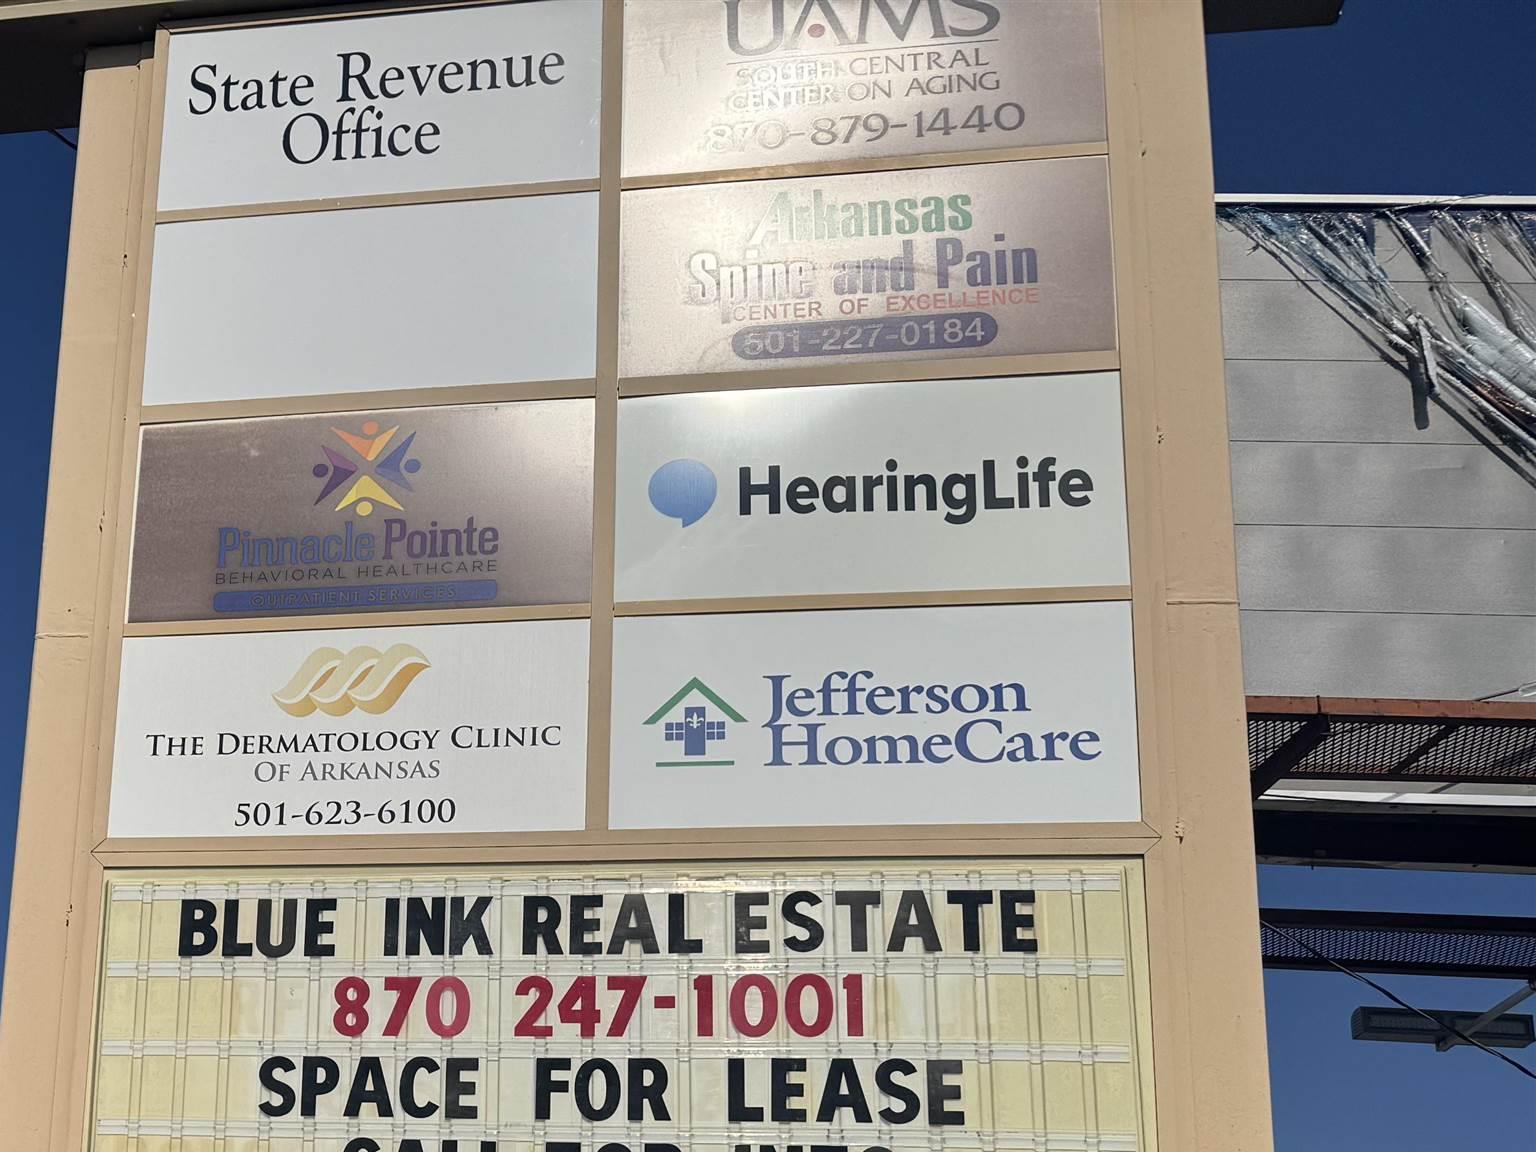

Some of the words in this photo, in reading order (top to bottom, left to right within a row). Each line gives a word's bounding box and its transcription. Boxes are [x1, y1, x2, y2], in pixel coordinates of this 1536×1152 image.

[723, 0, 1001, 56] UAMS
[189, 63, 314, 115] State
[336, 50, 565, 103] Revenue
[847, 80, 892, 101] ON
[905, 71, 1000, 96] AGING
[849, 48, 990, 76] CENTRAL
[282, 106, 441, 164] Office
[706, 102, 1025, 152] 870-879-1440
[750, 189, 973, 246] Arkansas
[687, 247, 815, 324] Spine
[833, 239, 913, 295] and
[936, 234, 1038, 289] Pain
[733, 301, 821, 322] CENTER
[839, 298, 869, 316] OF
[886, 288, 1039, 312] EXCELLENCE
[743, 317, 985, 355] 501-227-0184
[739, 456, 1094, 525] HearingLife
[217, 521, 375, 569] Pinnacle
[382, 516, 499, 561] Pointe
[215, 566, 346, 585] BEHAVIORAL
[358, 560, 498, 578] HEALTHCARE
[250, 592, 359, 608] OUTPATIENT
[368, 585, 456, 601] SERVICES
[761, 671, 1031, 728] Jefferson
[146, 734, 204, 757] THE
[217, 728, 441, 755] DERMATOLOGY
[450, 725, 561, 749] CLINIC
[763, 719, 1102, 767] HomeCare
[254, 761, 291, 782] OF
[300, 759, 441, 780] ARKANSAS
[234, 798, 456, 827] 501-623-6100
[178, 898, 337, 958] BLUE
[384, 895, 493, 956] INK
[522, 893, 703, 955] REAL
[735, 889, 1038, 953] ESTATE
[332, 975, 470, 1038] 870
[514, 973, 864, 1038] 247-1001
[258, 1056, 479, 1120] SPACE
[535, 1057, 671, 1121] FOR
[728, 1058, 965, 1126] LEASE
